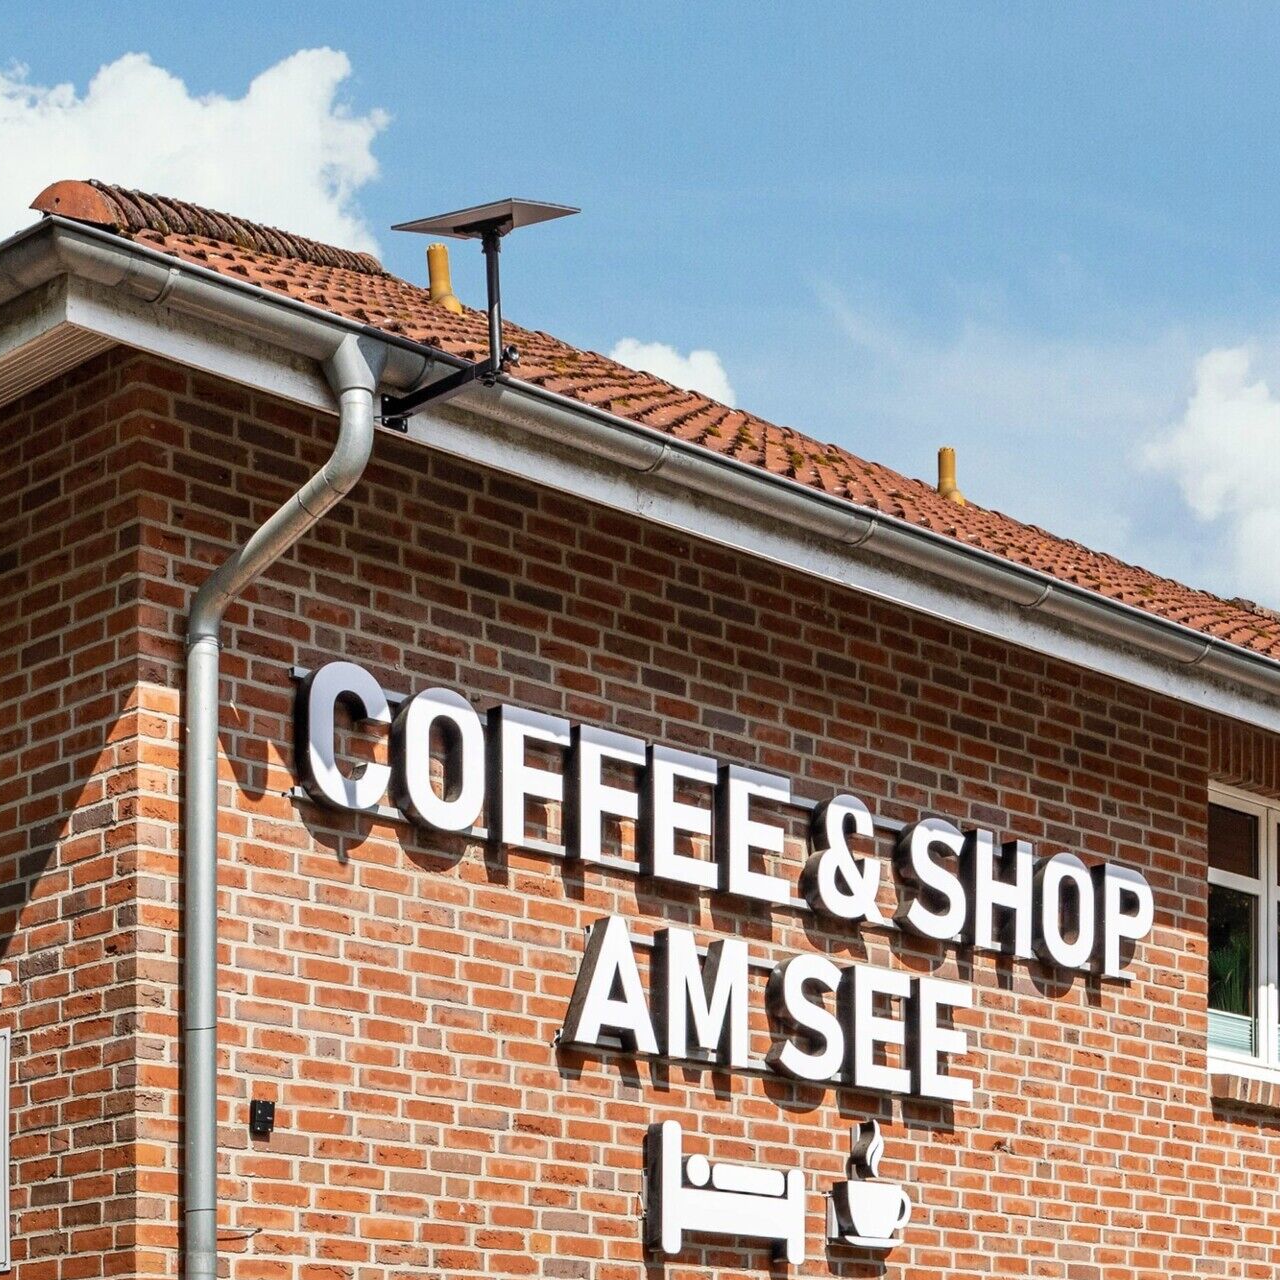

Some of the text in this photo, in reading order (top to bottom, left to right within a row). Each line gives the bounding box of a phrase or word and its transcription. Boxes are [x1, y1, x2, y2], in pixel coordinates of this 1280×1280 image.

[298, 661, 1155, 980] COFFEE & SHOP
[567, 916, 974, 1103] AM SEE
